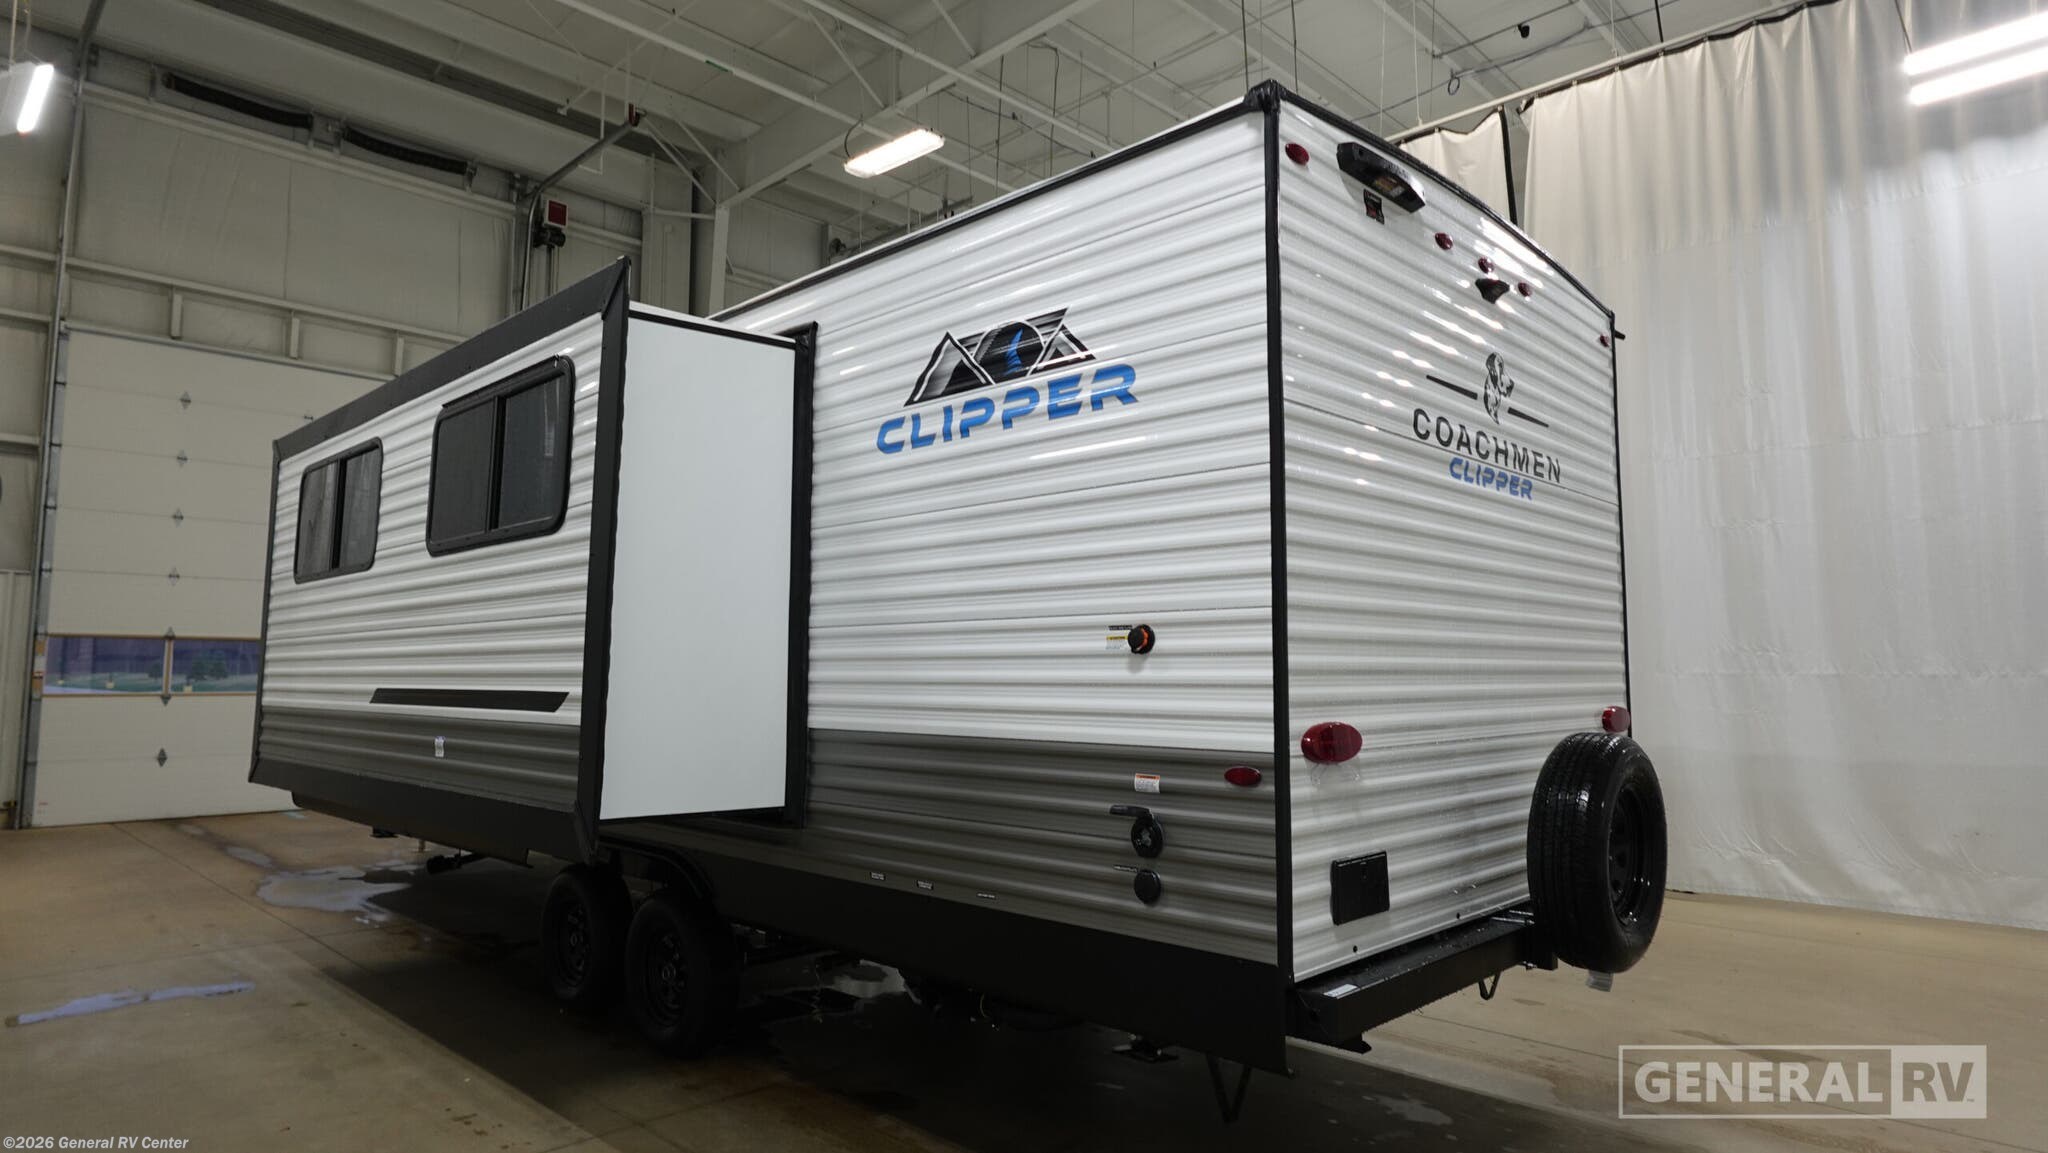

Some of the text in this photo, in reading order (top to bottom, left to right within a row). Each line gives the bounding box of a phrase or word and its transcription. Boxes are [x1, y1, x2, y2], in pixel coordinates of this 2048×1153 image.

[877, 364, 1138, 454] CLIPPER
[1413, 408, 1561, 483] COACHMEN
[1450, 457, 1533, 500] CLIPPER
